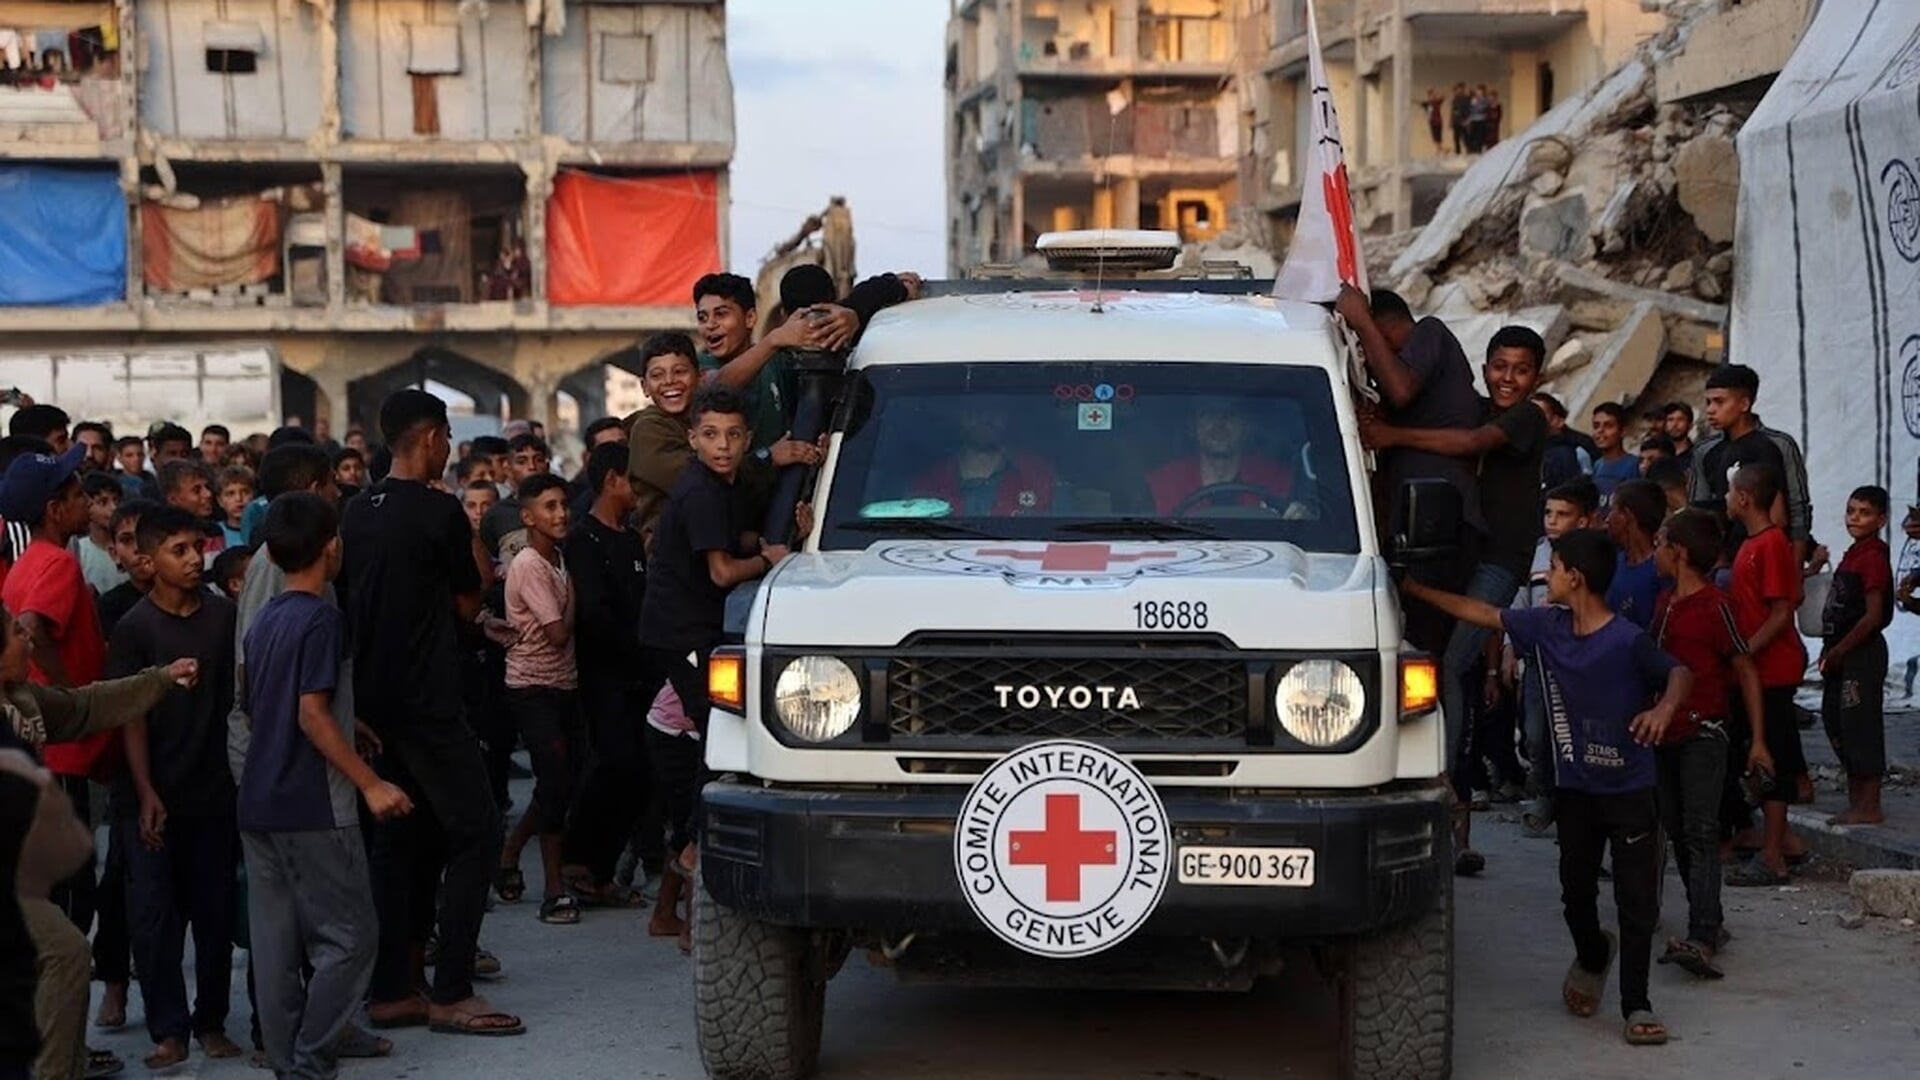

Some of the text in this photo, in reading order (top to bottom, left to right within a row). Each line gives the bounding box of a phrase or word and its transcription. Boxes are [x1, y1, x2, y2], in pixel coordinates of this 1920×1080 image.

[1133, 601, 1208, 629] 18688
[994, 685, 1141, 709] TOYOTA
[1586, 743, 1619, 758] STARS
[967, 751, 1160, 895] COMITE INTERNATIONAL
[1267, 854, 1310, 880] 367
[1006, 906, 1125, 946] GENEVE
